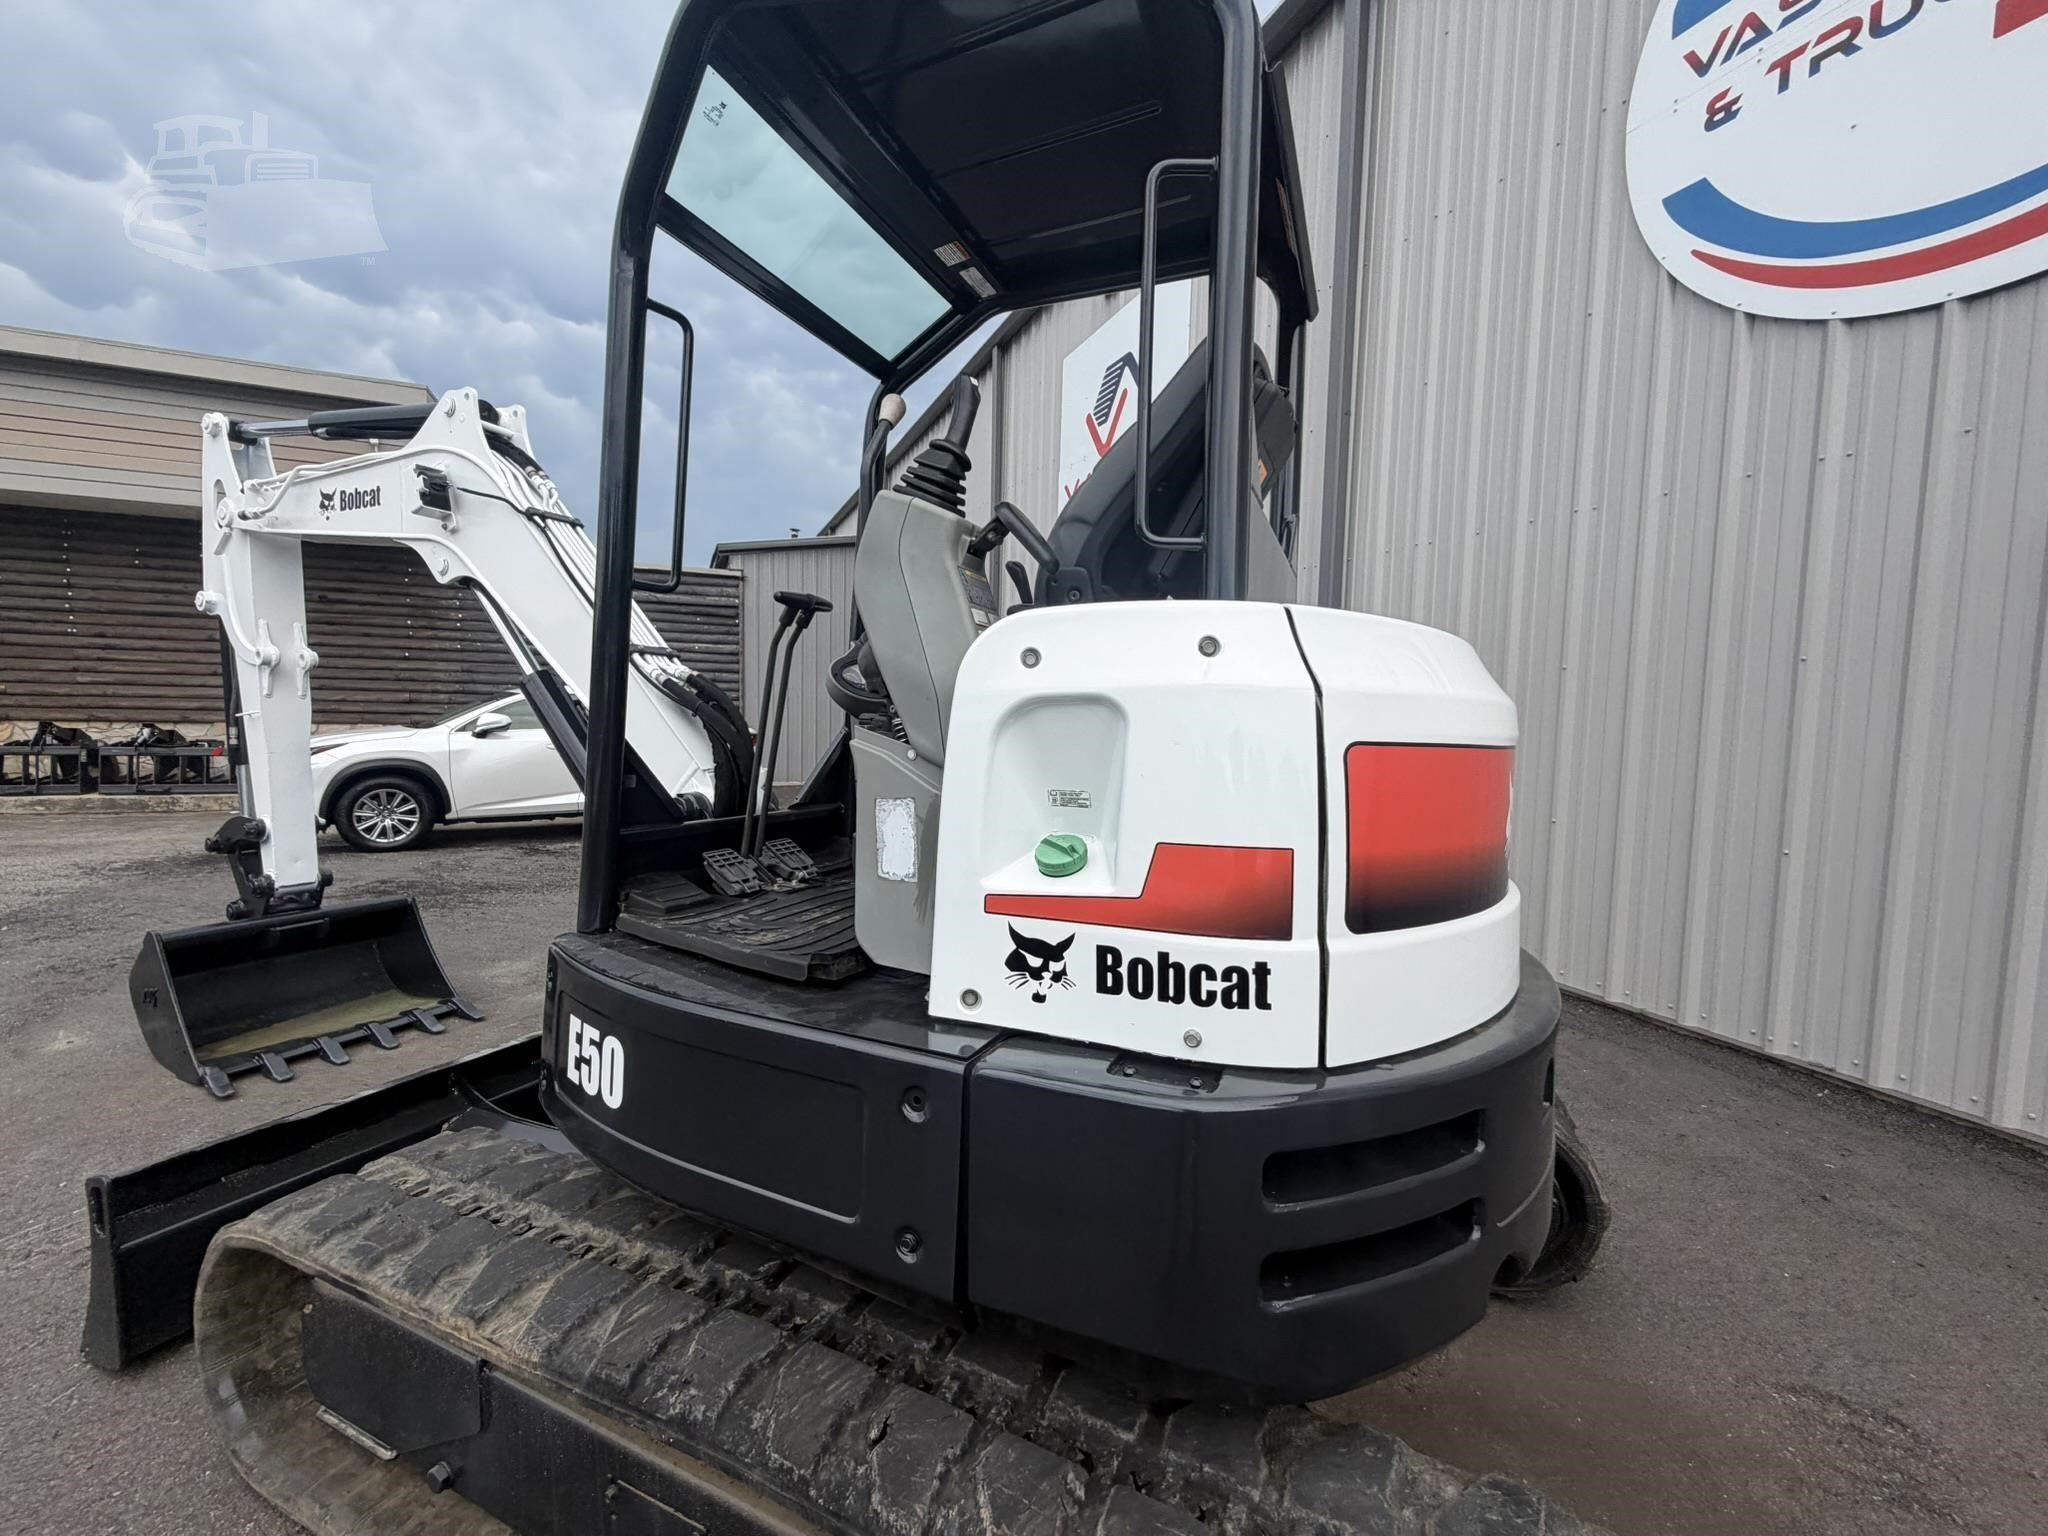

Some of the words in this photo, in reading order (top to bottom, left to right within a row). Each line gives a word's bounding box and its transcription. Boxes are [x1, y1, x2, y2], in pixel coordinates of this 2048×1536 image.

[1704, 86, 1743, 132] &
[340, 485, 381, 512] Bobcat
[1096, 944, 1272, 1011] Bobcat
[567, 1013, 624, 1110] E50
